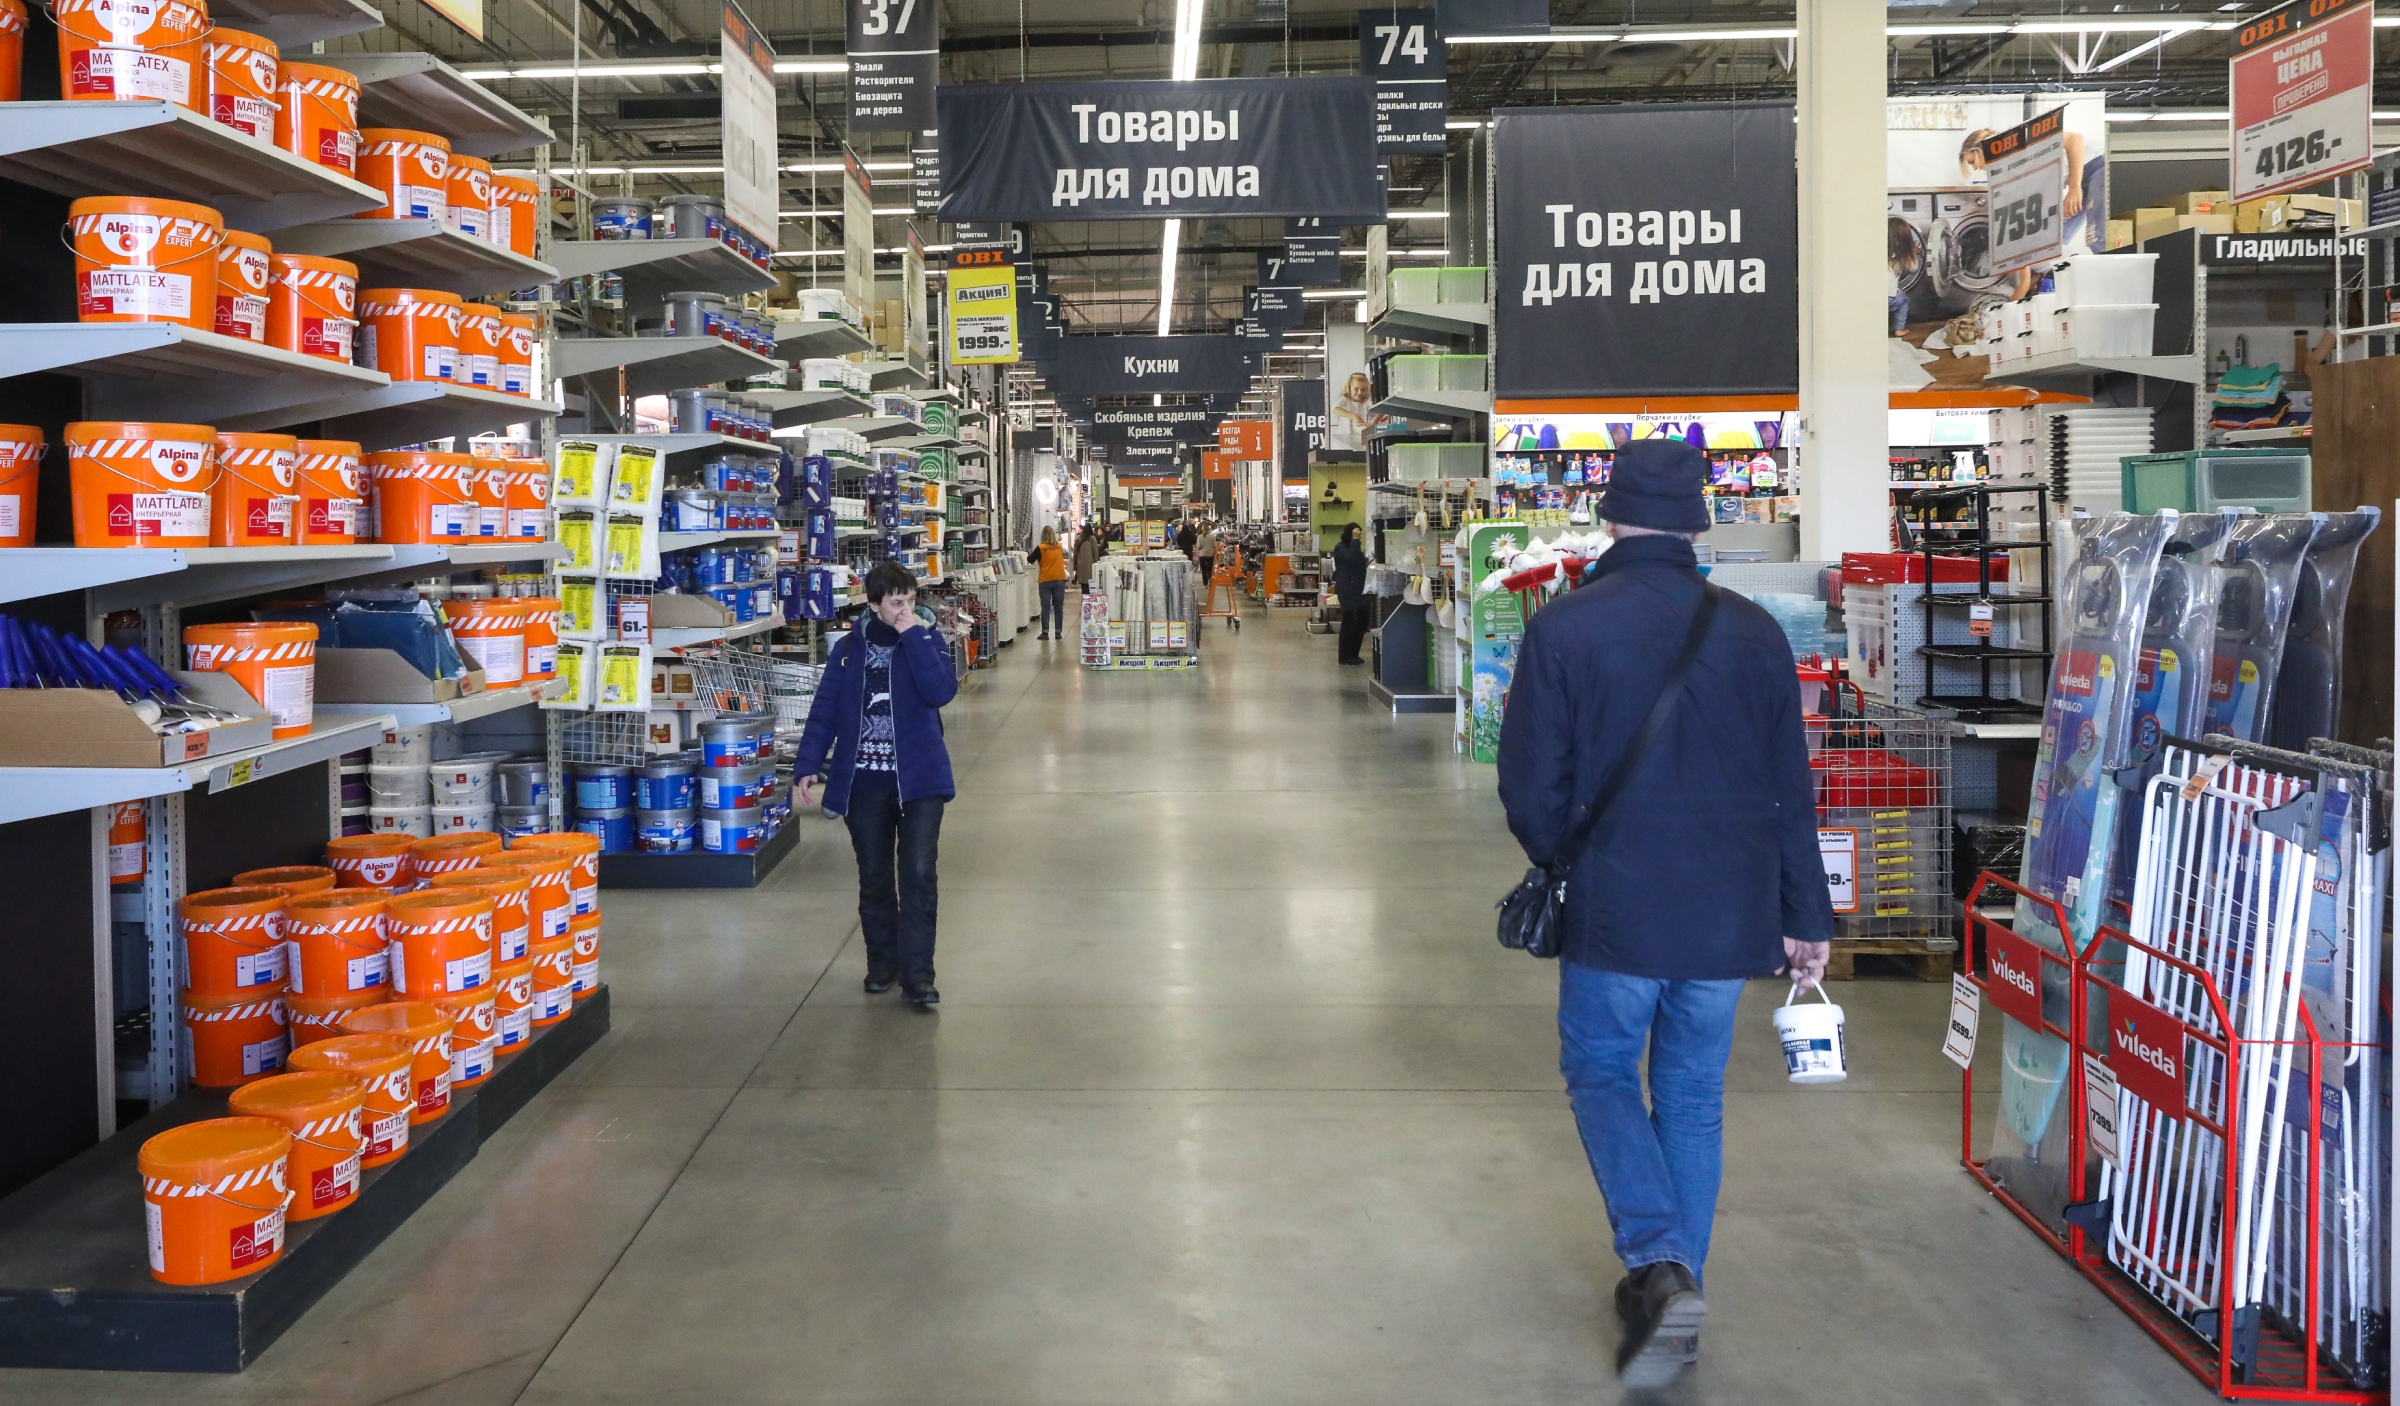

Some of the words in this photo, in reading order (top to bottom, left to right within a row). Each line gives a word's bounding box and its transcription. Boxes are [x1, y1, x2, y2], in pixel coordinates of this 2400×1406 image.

[862, 0, 916, 36] 37
[161, 18, 187, 33] EXPERT
[725, 6, 746, 46] OBI
[2240, 12, 2289, 47] OBI
[1375, 25, 1428, 65] 74
[2272, 30, 2328, 63] ВЫГОДНАЯ
[854, 62, 884, 72] Эмали
[2277, 49, 2323, 85] ЦЕНА
[855, 75, 914, 86] Растворители
[855, 91, 903, 102] Биозащита
[2277, 75, 2326, 110] ПРОВЕРЕНО
[855, 106, 871, 117] для
[873, 105, 903, 117] дерева
[1419, 101, 1443, 110] доски
[1072, 103, 1239, 151] Товары
[2031, 114, 2059, 138] OBI
[1406, 134, 1421, 143] для
[1422, 132, 1446, 142] белья
[1990, 132, 2019, 156] OBI
[2255, 129, 2342, 178] 4126,-
[1052, 166, 1130, 206] для
[1143, 164, 1261, 206] дома
[917, 189, 932, 197] Воск
[1994, 192, 2058, 247] 759,-
[105, 221, 154, 236] Alpina
[956, 231, 988, 240] Герметики
[1545, 204, 1741, 255] Товары
[165, 235, 194, 249] EXPERT
[2216, 236, 2366, 261] Гладильные
[957, 251, 1004, 265] OBI
[92, 272, 166, 288] MATTLATEX
[1522, 262, 1612, 306] для
[1630, 258, 1766, 304] дома
[958, 286, 1008, 301] Акция!
[957, 335, 1010, 350] 1999,-
[1124, 356, 1179, 378] Кухни
[1095, 411, 1154, 424] Скобяные
[1157, 411, 1206, 423] изделия
[1636, 414, 1670, 423] Перчатки
[1681, 413, 1702, 423] губки
[1127, 426, 1174, 439] Крепеж
[1222, 427, 1241, 435] ВСЕГДА
[1224, 437, 1239, 445] РАДЫ
[158, 448, 199, 462] Alpina
[1126, 446, 1173, 456] Электрика
[136, 497, 203, 511] MATTLATEX
[136, 510, 182, 519] ИНТЕРЬЕРНАЯ
[195, 661, 213, 670] EXPERT
[1119, 660, 1147, 668] Акция!
[1153, 660, 1181, 668] Акция!
[2160, 656, 2177, 667] NEW
[2240, 668, 2256, 679] NEW
[120, 814, 143, 826] EXPERT
[364, 861, 394, 872] Alpina
[1826, 873, 1852, 886] 9,-
[1992, 953, 2035, 997] vileda
[2115, 1028, 2176, 1079] vileda
